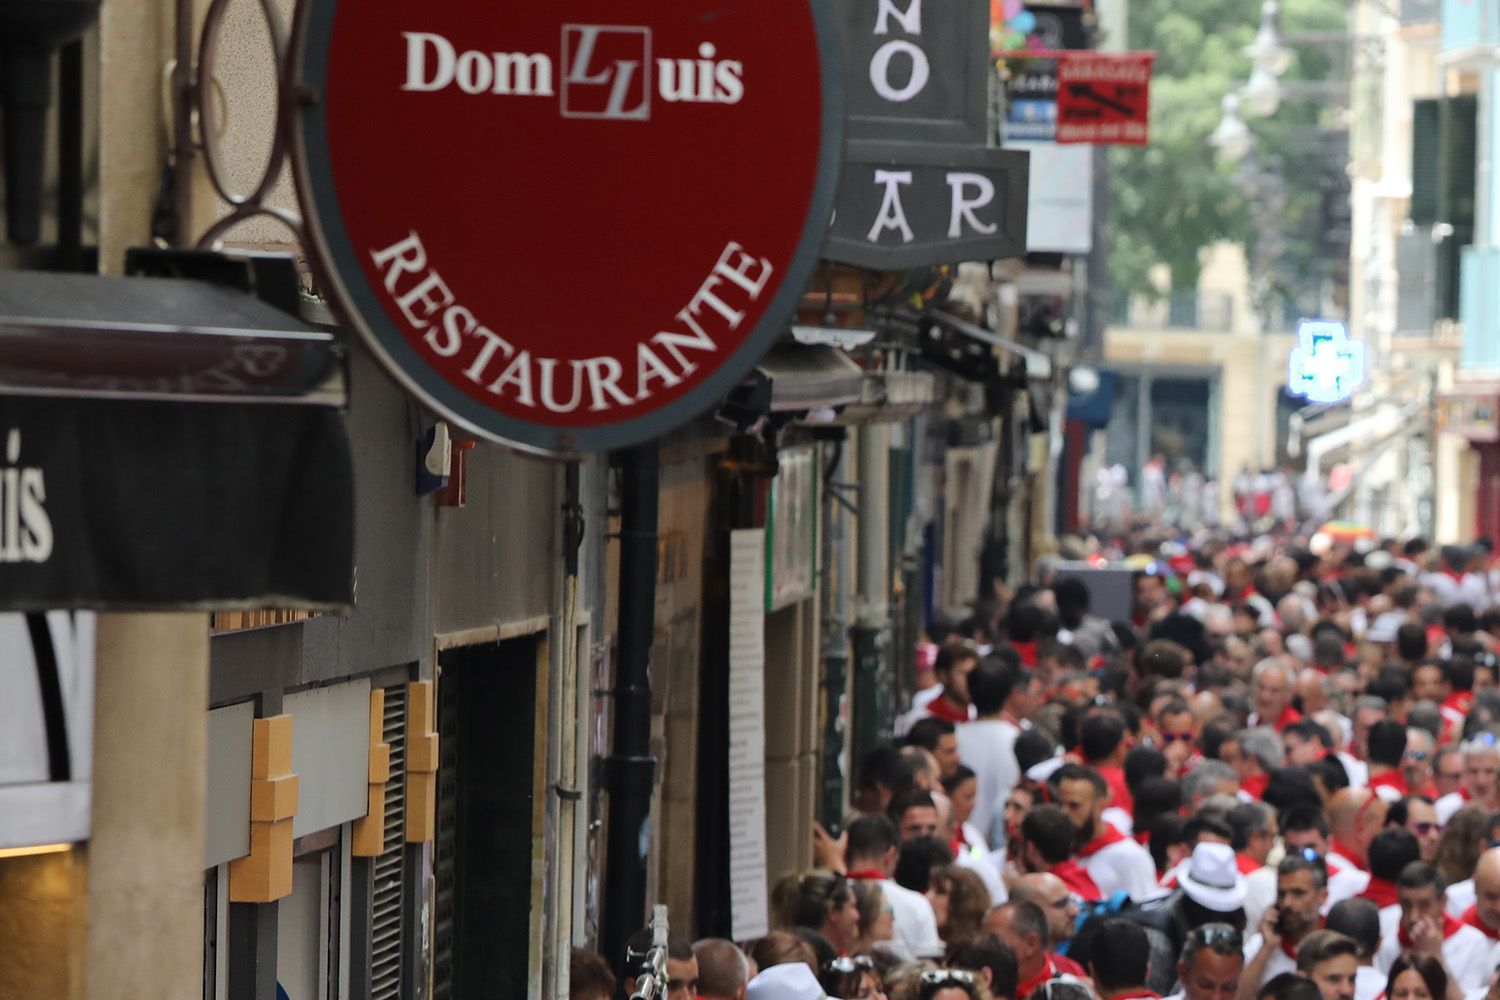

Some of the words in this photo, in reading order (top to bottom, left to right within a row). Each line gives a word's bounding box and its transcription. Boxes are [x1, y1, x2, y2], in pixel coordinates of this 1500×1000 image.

[402, 31, 554, 96] Dom
[829, 169, 998, 243] AR
[371, 230, 773, 413] RESTAURANTE
